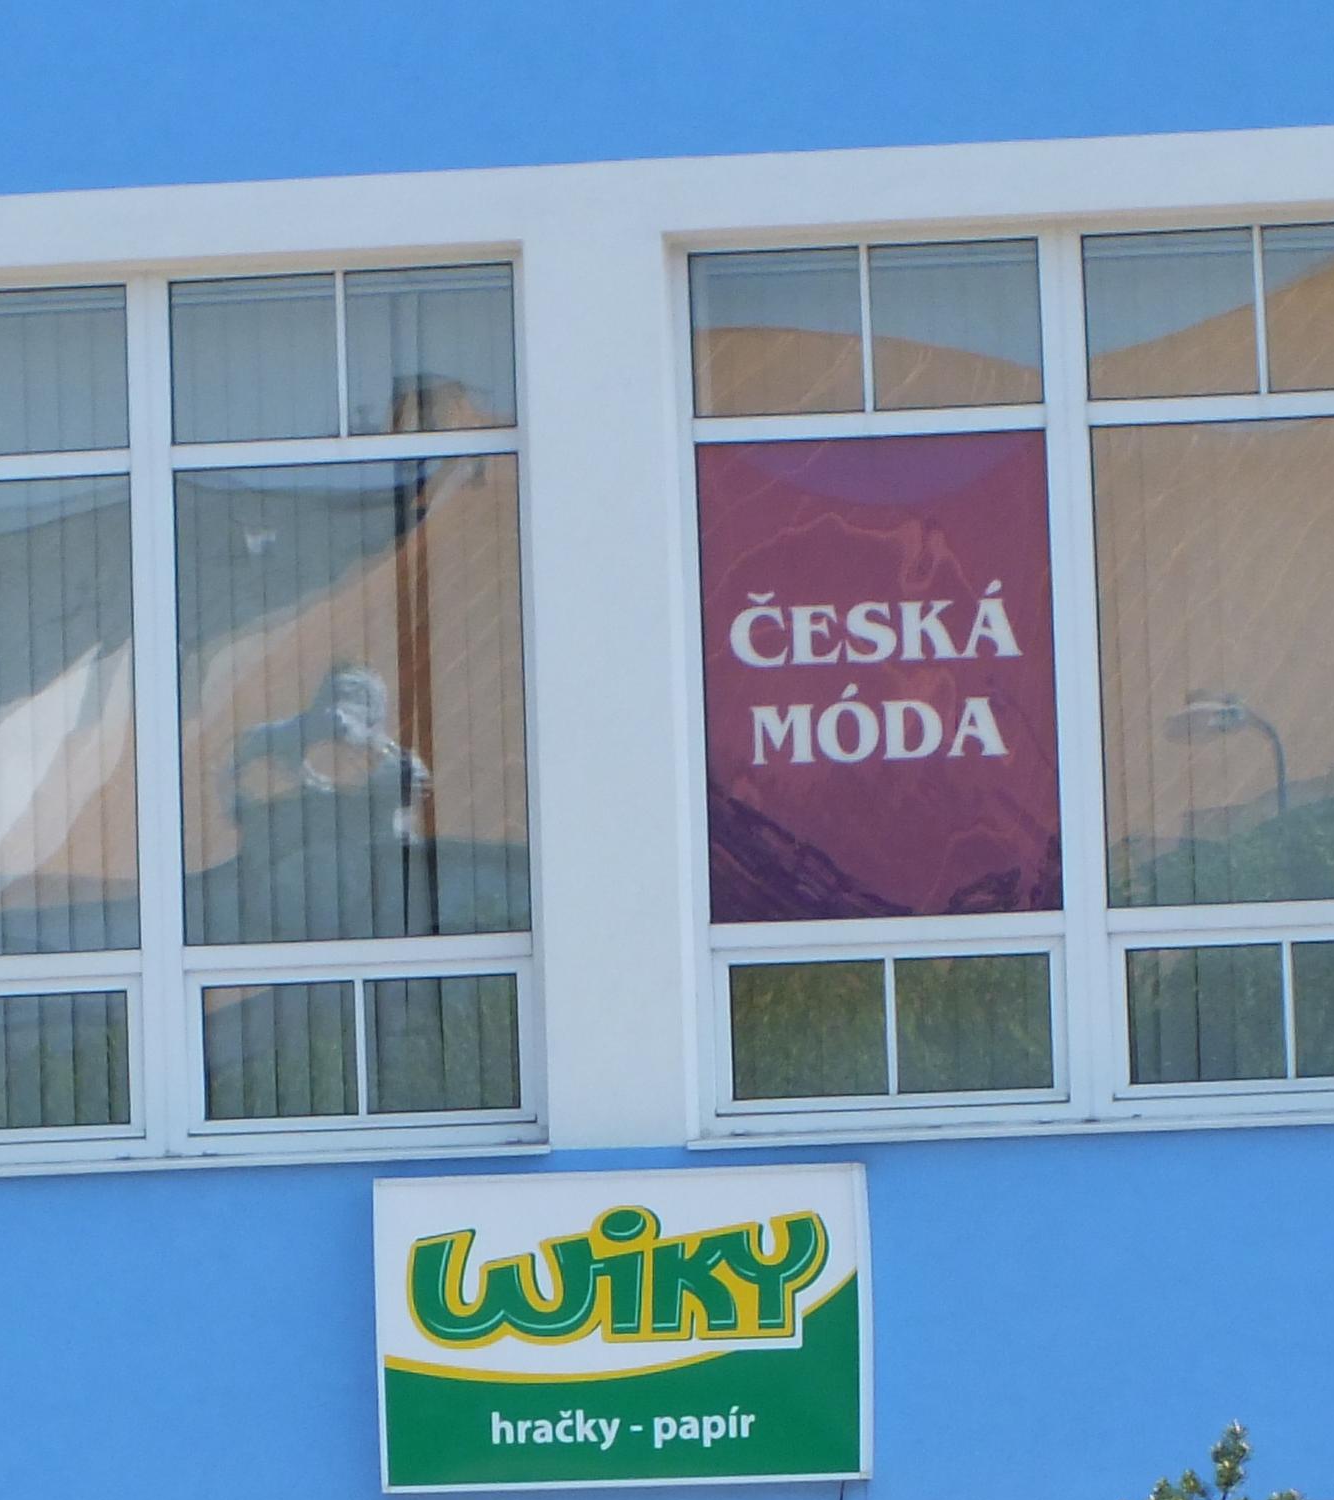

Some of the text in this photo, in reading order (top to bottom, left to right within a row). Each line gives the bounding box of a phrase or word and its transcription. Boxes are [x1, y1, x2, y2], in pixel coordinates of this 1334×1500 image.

[729, 579, 1024, 668] ČESKÁ
[749, 683, 1010, 766] MÓDA
[490, 1409, 621, 1450] hračky
[653, 1405, 756, 1449] papír
